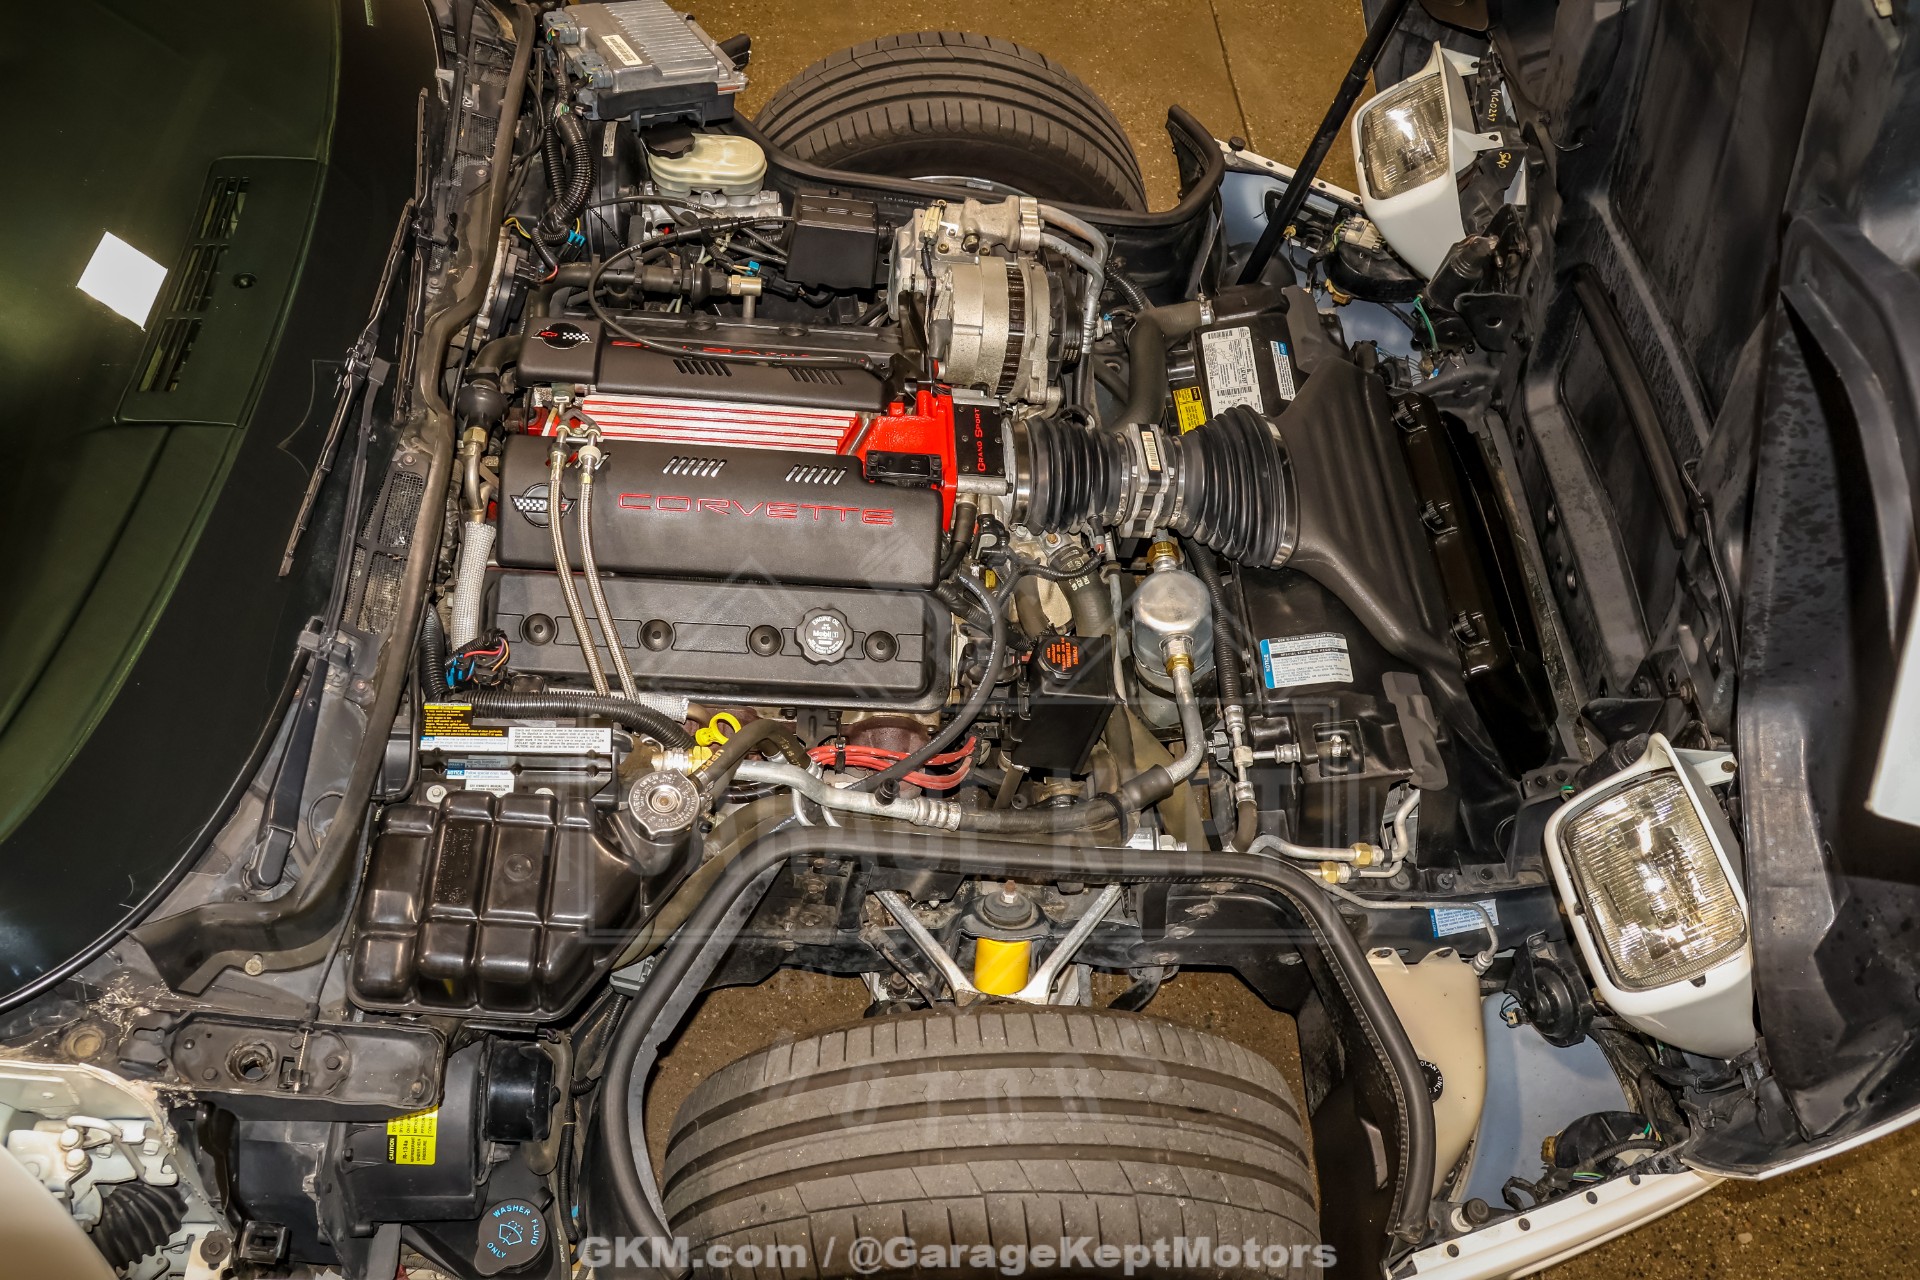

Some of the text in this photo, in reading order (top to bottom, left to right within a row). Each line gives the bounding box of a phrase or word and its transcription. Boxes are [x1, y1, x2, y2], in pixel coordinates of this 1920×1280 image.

[974, 407, 986, 472] GRAND SPORT
[618, 492, 895, 526] CORVETTE
[811, 615, 841, 628] ENGINE OIL
[812, 630, 832, 638] Mobil
[1419, 1060, 1443, 1093] OLANT ONLY
[487, 1204, 540, 1258] WASHER FLUID ONLY
